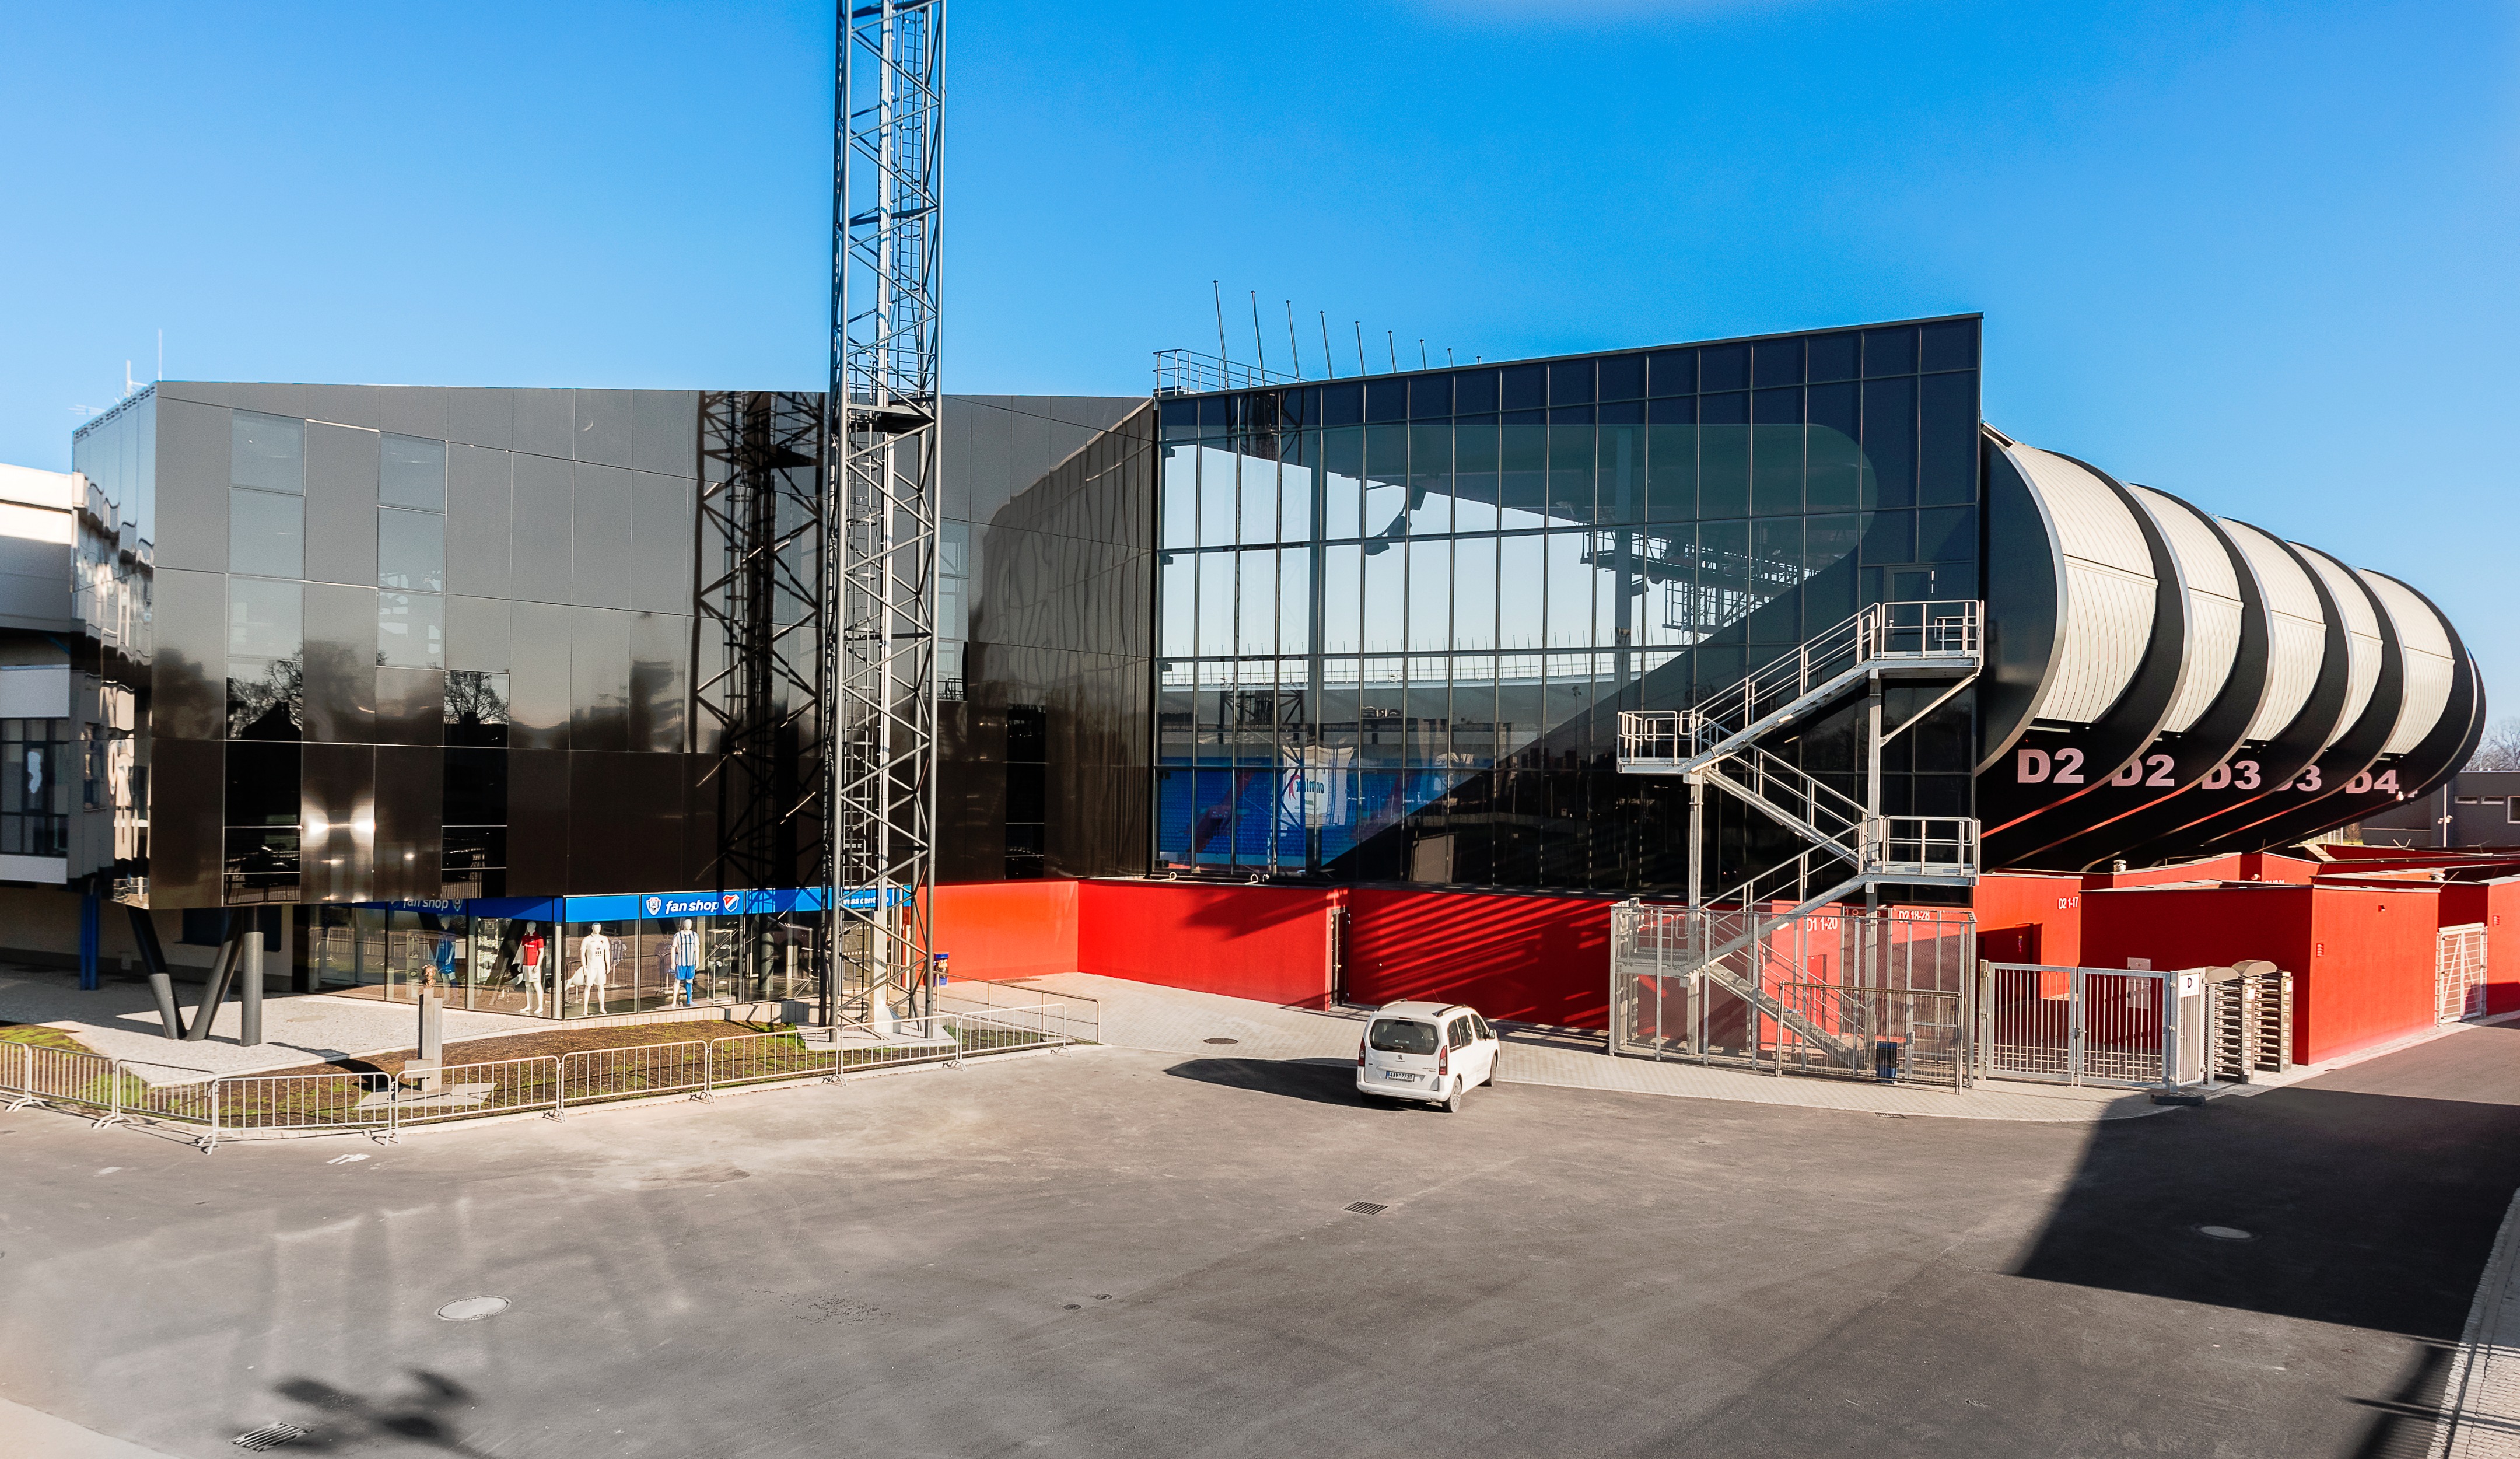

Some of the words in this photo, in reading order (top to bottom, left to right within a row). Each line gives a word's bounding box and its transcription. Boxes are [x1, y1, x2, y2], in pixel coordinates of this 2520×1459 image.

[2017, 748, 2084, 783] D2
[2111, 754, 2175, 786] D2
[2202, 760, 2261, 790] D3
[2275, 765, 2322, 792] 3
[2346, 769, 2400, 794] D4
[665, 900, 687, 915] fan
[688, 900, 720, 912] shop
[2058, 898, 2067, 909] D2
[2067, 896, 2079, 908] 1-17
[1807, 918, 1817, 932] D1
[1820, 916, 1838, 930] 1-20
[2188, 977, 2192, 988] D
